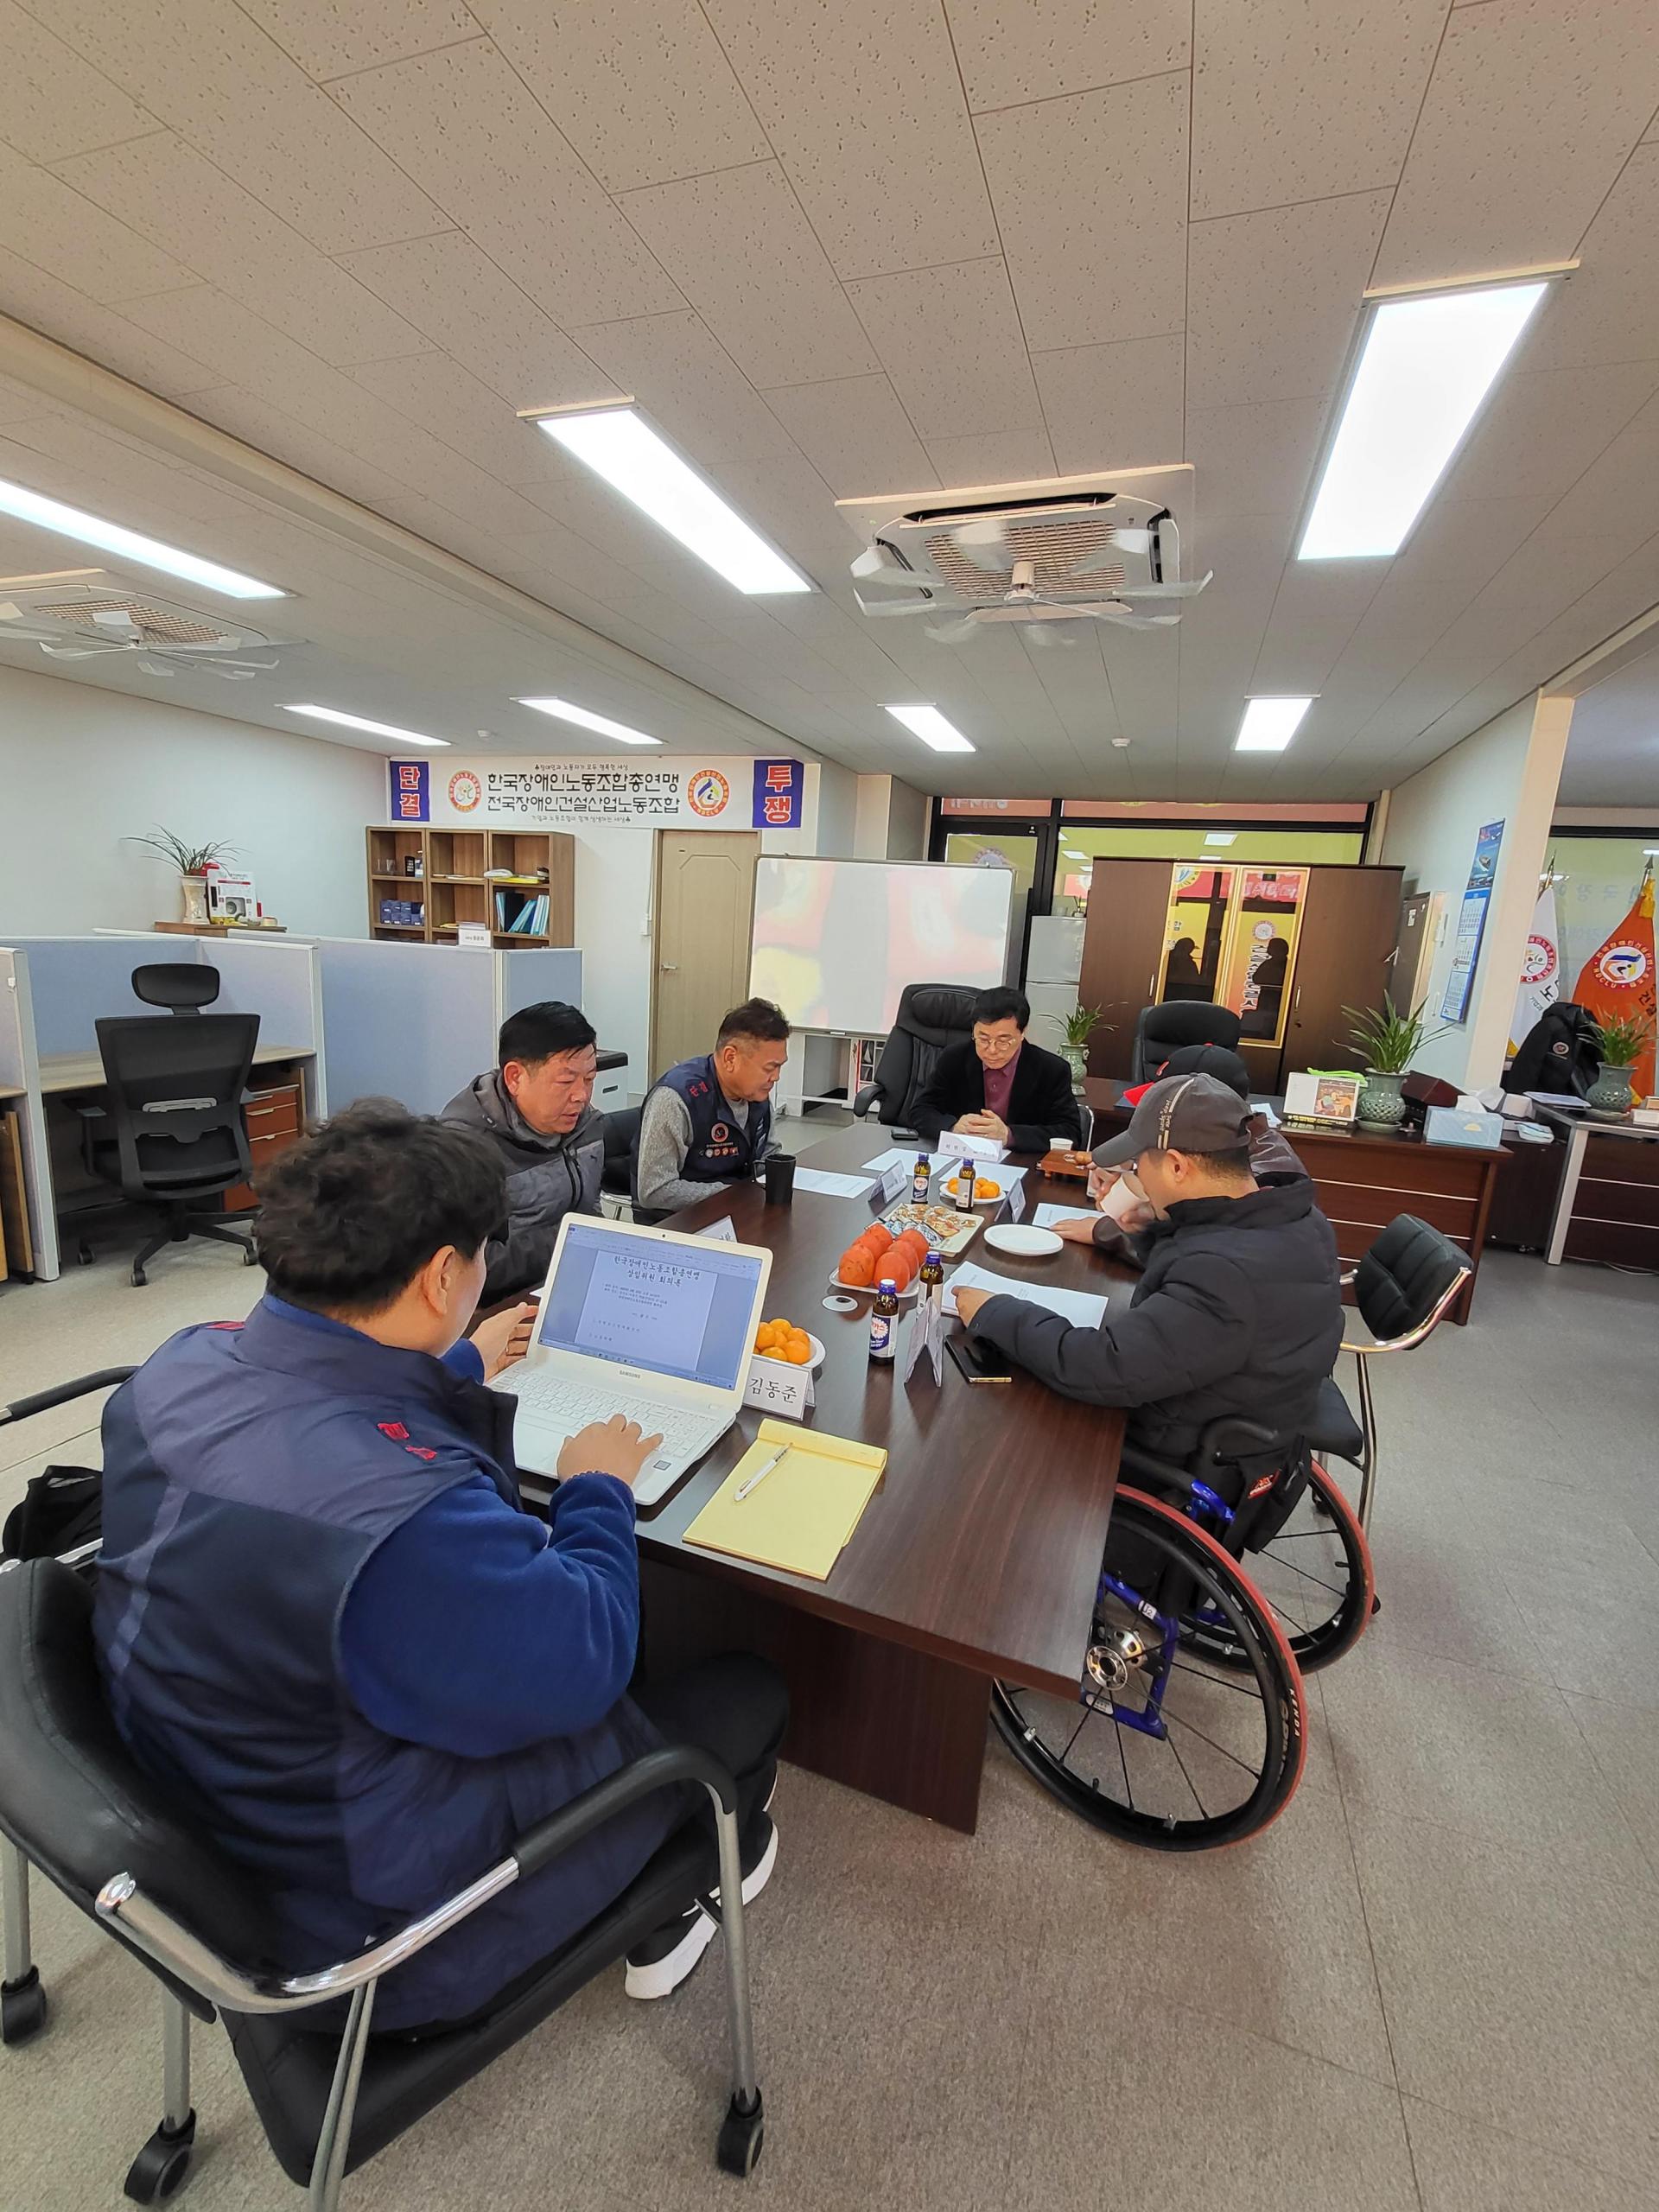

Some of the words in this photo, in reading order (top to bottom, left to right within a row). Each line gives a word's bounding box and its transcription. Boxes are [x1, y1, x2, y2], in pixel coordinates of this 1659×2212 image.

[399, 766, 421, 817] 단결
[487, 772, 680, 793] 한국장애인노동조합총연맹
[763, 765, 792, 824] 투쟁
[487, 796, 681, 814] 전국장애인건설산업노동조합
[748, 1376, 797, 1404] 김동준
[1289, 1688, 1300, 1737] KENDA
